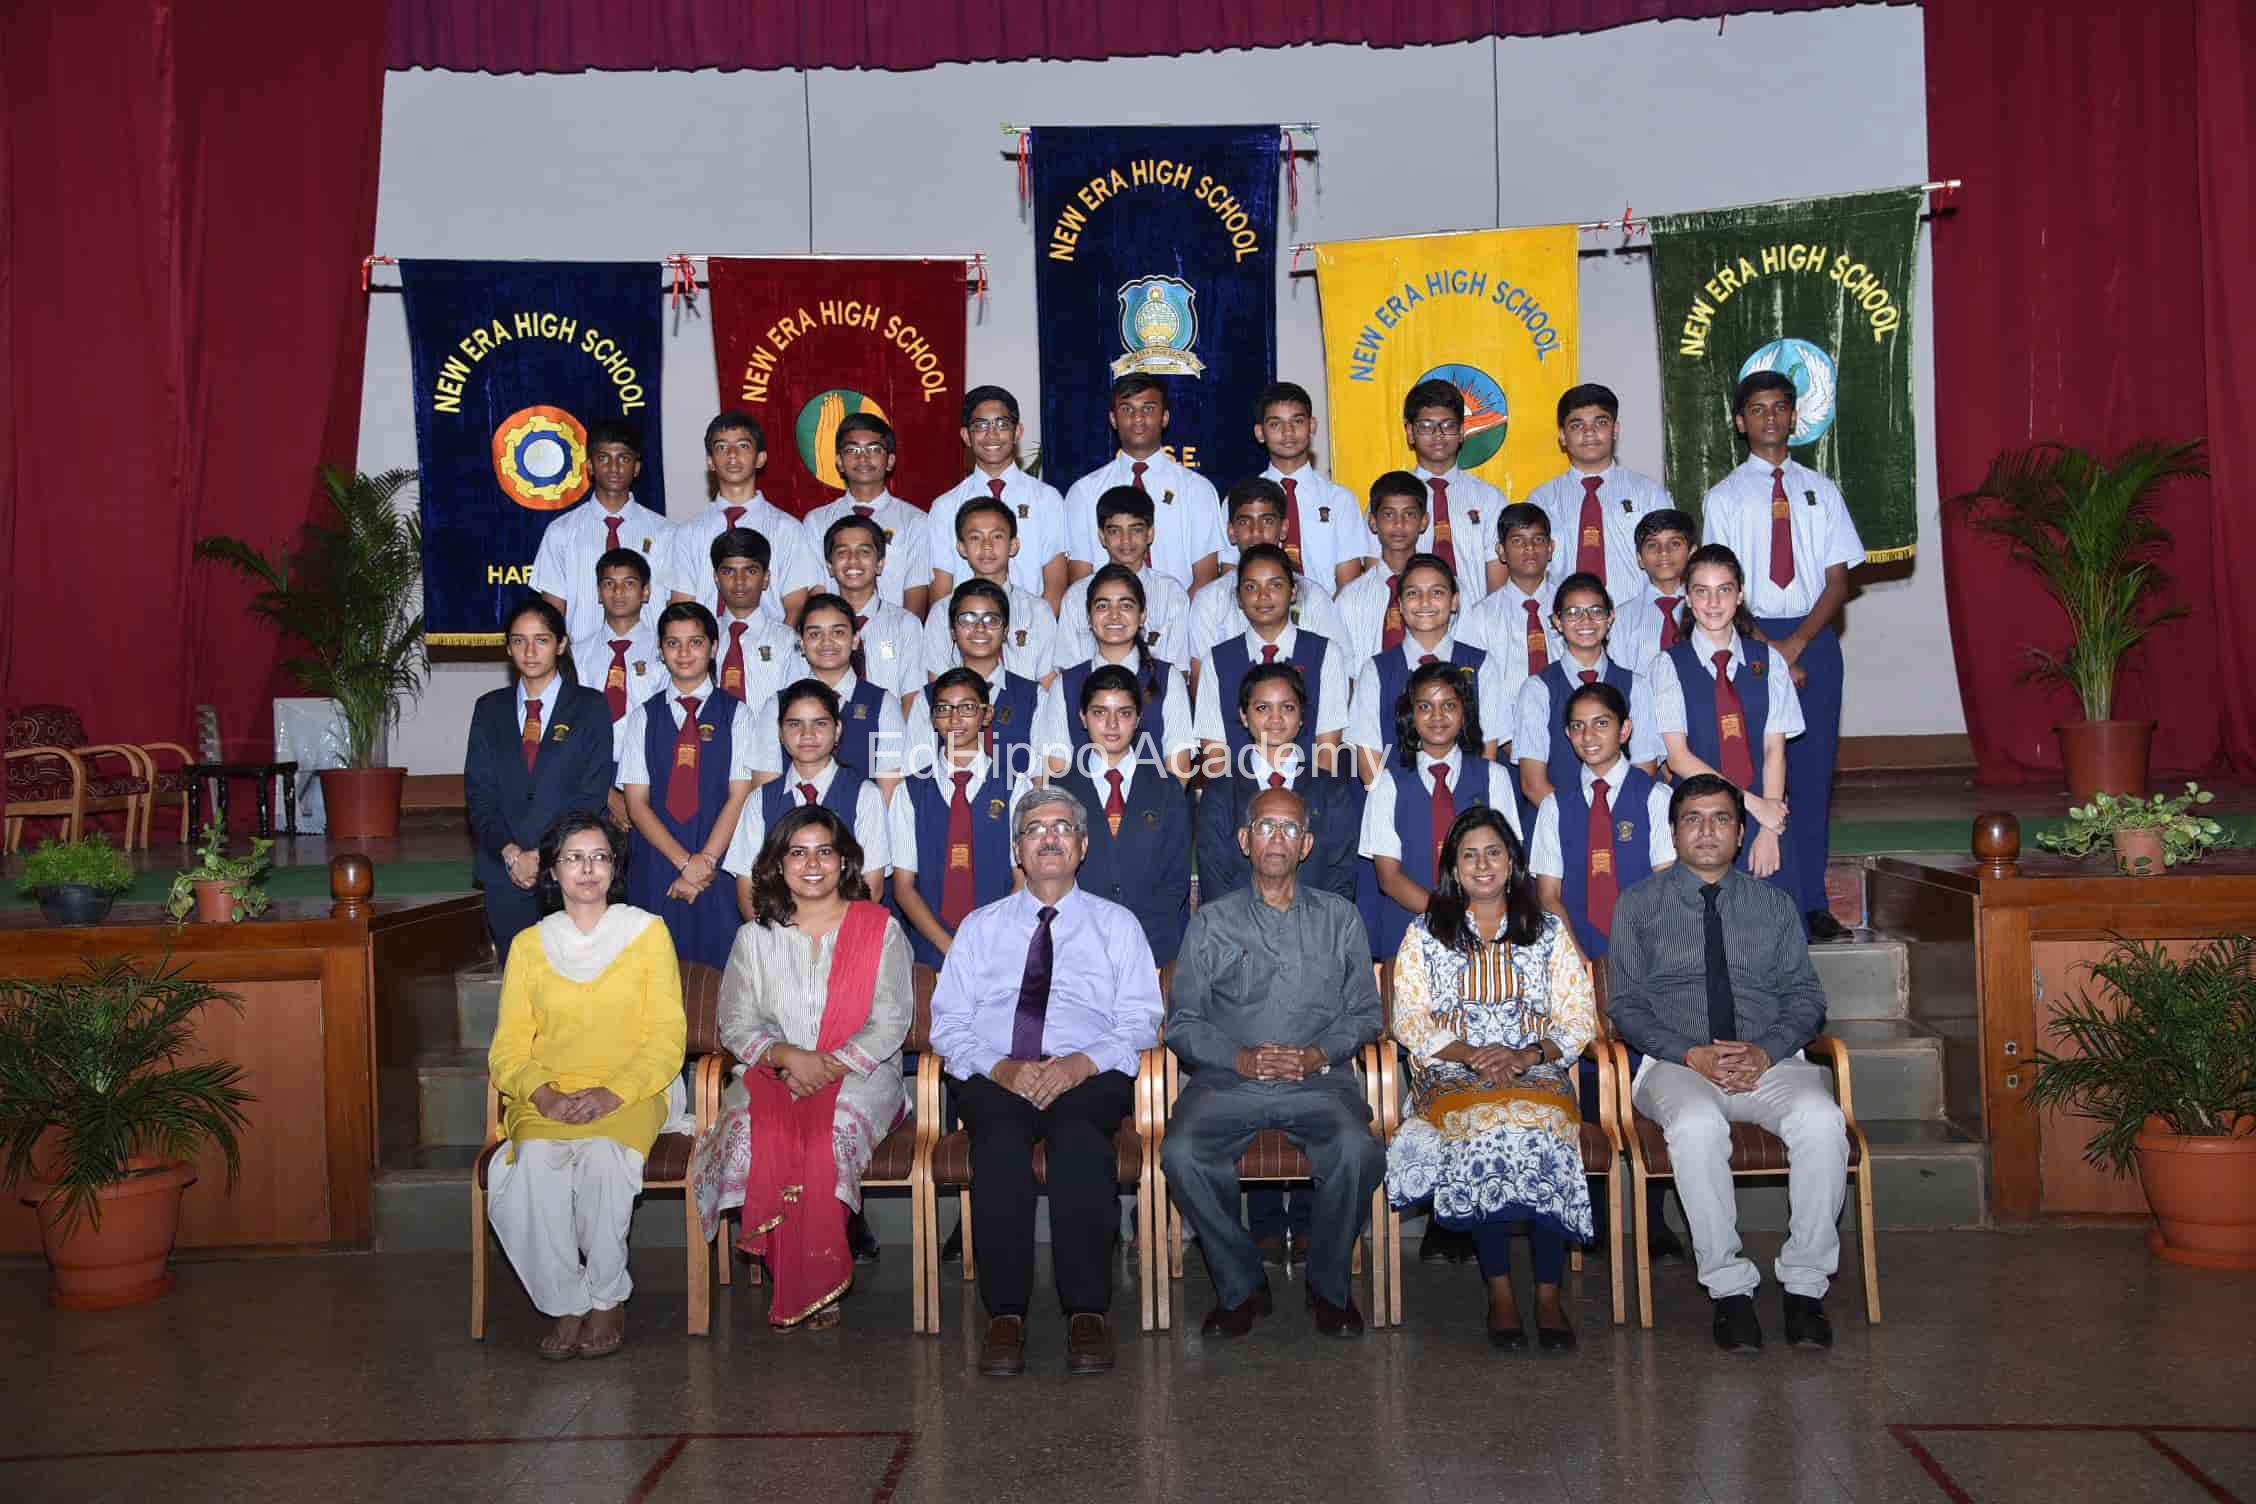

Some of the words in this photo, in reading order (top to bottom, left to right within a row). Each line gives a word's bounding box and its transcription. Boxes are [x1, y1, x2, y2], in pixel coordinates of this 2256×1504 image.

[1049, 205, 1087, 261] NEW
[1078, 169, 1128, 210] ERA
[1131, 159, 1192, 189] HIGH
[1194, 176, 1259, 263] SCHOOL
[742, 345, 777, 403] NEW
[766, 308, 816, 350] ERA
[819, 300, 880, 331] HIGH
[884, 316, 947, 403] SCHOOL
[1349, 325, 1384, 382] NEW
[1375, 283, 1424, 329] ERA
[1425, 269, 1487, 297] HIGH
[1492, 281, 1561, 362] SCHOOL
[1680, 296, 1715, 357] NEW
[1705, 257, 1759, 304] ERA
[1761, 244, 1827, 274] HIGH
[1829, 254, 1899, 343] SCHOOL
[434, 355, 471, 413] NEW
[460, 319, 512, 362] ERA
[513, 312, 577, 343] HIGH
[581, 328, 646, 416] SCHOOL
